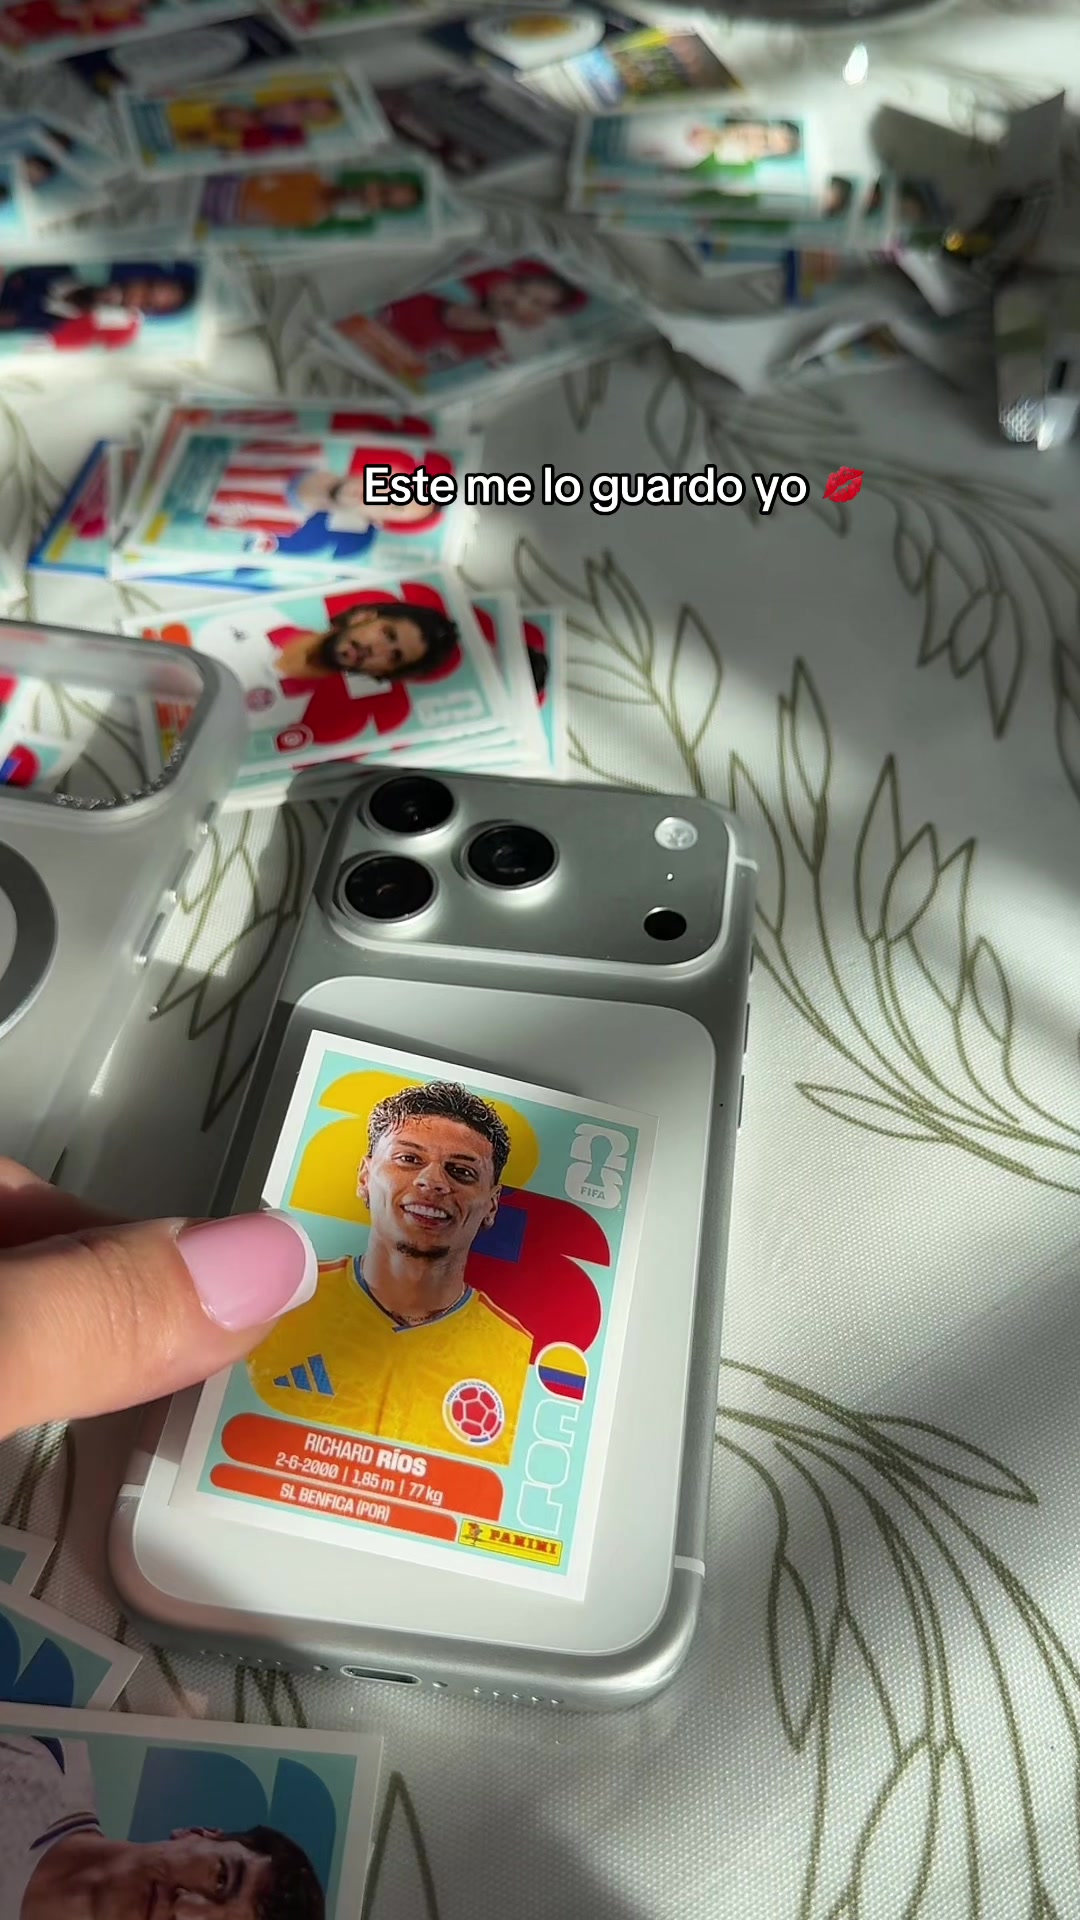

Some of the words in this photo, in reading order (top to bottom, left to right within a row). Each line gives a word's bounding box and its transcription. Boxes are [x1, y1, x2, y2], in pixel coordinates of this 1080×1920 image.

[580, 1186, 606, 1200] FIFA
[304, 1432, 375, 1464] RICHARD
[376, 1448, 427, 1478] RÍOS
[516, 1398, 580, 1536] COL
[275, 1452, 340, 1479] 2-6-2000
[352, 1469, 380, 1489] 1,85
[381, 1479, 395, 1493] m
[408, 1482, 425, 1499] 77
[425, 1486, 443, 1506] kg
[279, 1483, 297, 1500] SL
[299, 1487, 354, 1514] BENFICA
[356, 1499, 391, 1523] (POR)
[488, 1528, 558, 1555] PANINI
